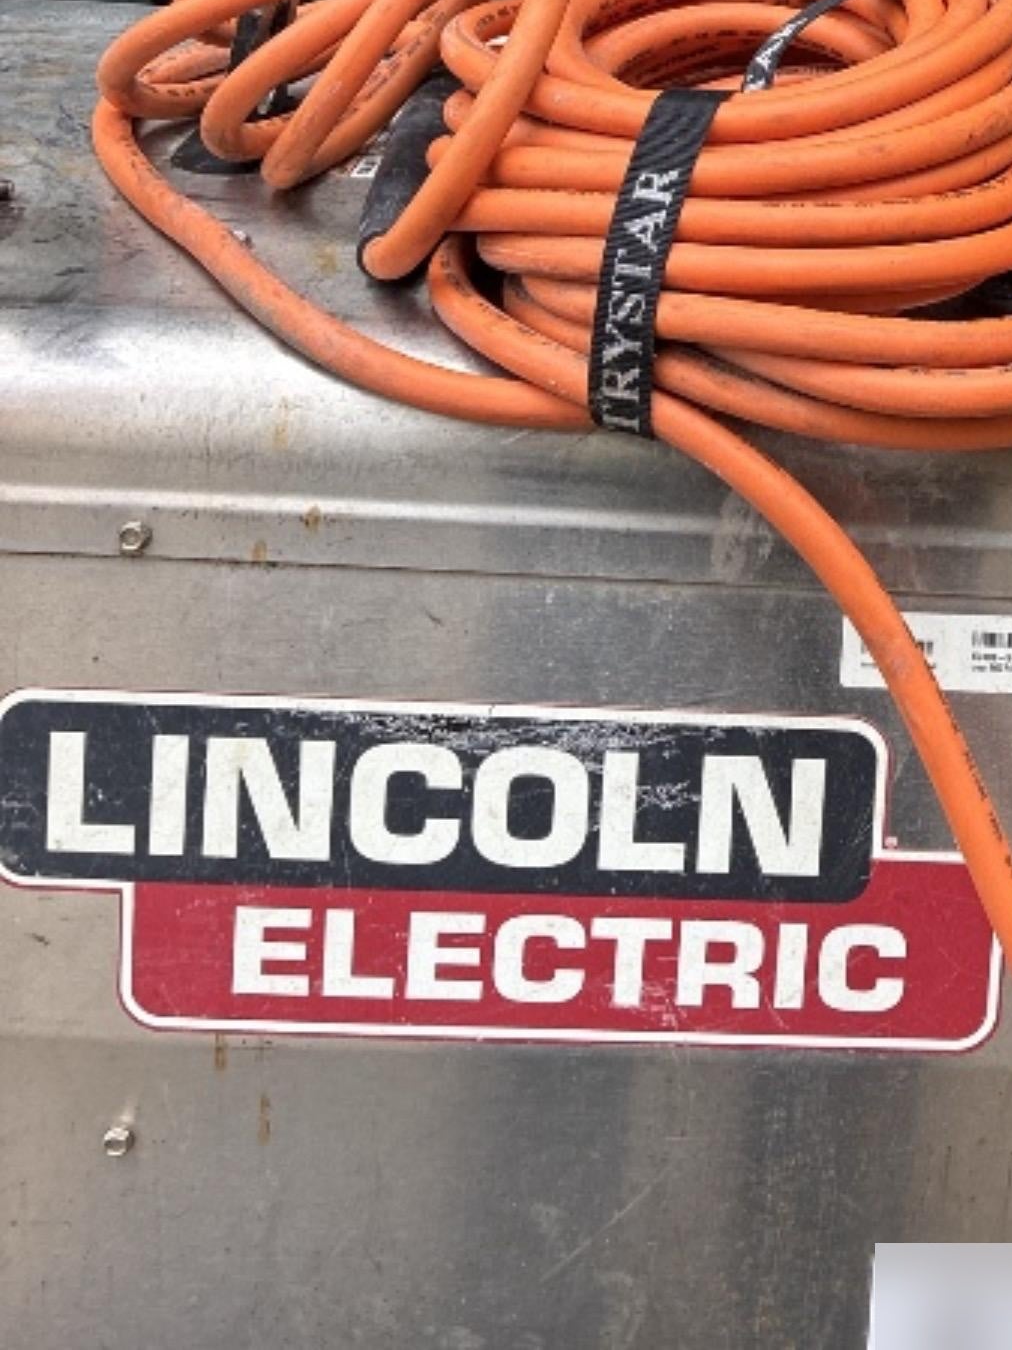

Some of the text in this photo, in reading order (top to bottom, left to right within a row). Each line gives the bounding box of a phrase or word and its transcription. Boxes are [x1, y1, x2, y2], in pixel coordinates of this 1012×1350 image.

[601, 168, 680, 434] TRYSTAR
[46, 730, 827, 878] LINCOLN
[231, 906, 908, 1013] ELECTRIC
